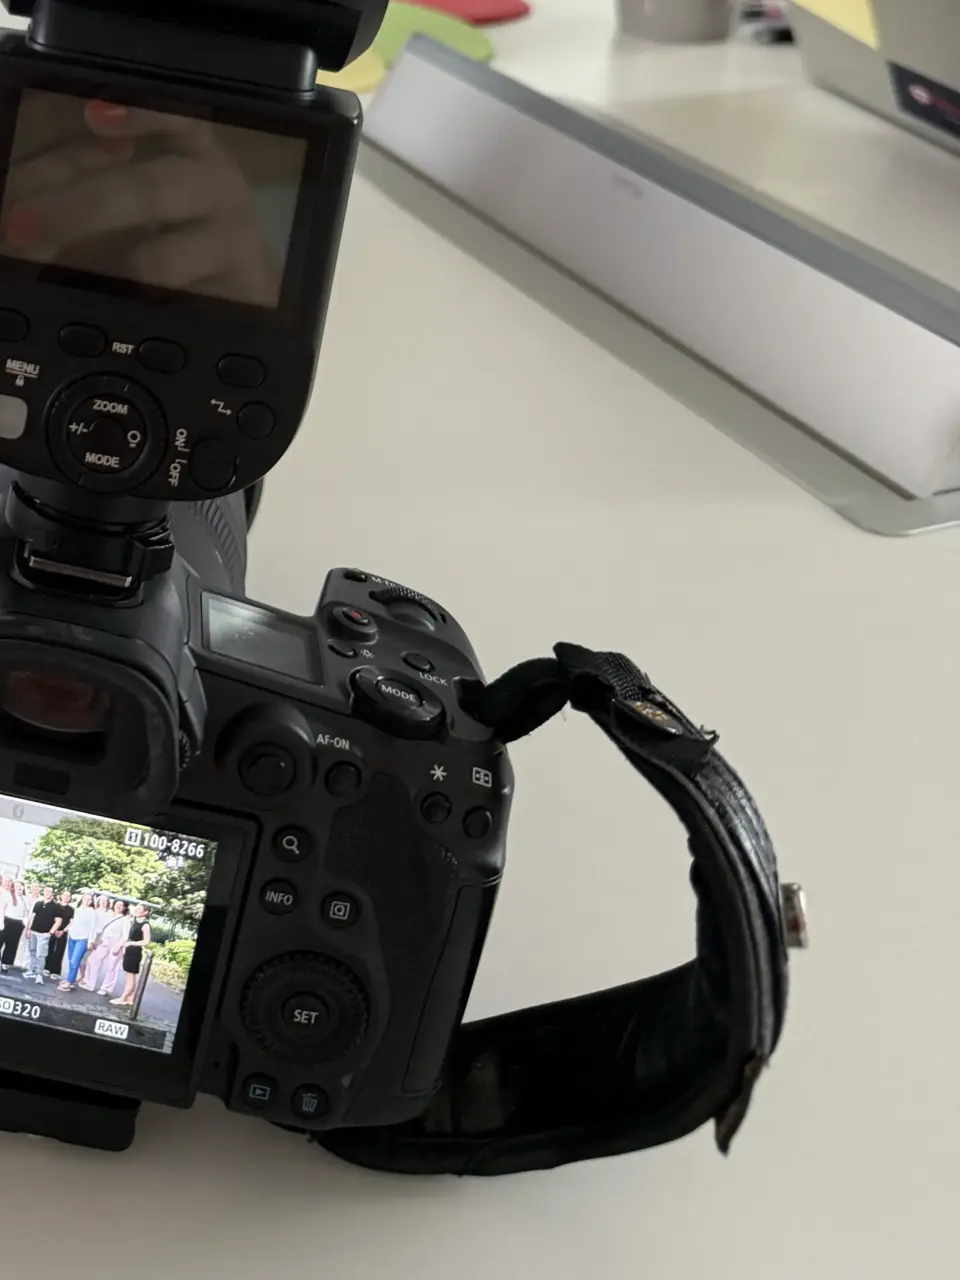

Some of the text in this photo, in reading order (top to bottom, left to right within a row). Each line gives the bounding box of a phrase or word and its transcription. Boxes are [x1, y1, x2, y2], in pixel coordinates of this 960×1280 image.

[112, 341, 135, 355] RST
[5, 358, 40, 375] MENU
[92, 399, 128, 415] ZOOM
[174, 428, 187, 446] ON
[84, 452, 121, 468] MODE
[168, 463, 181, 487] OFF
[419, 671, 448, 686] LOCK
[381, 683, 417, 703] MODE
[316, 734, 350, 750] AF-ON
[143, 832, 205, 858] 100-8266
[265, 890, 293, 906] INFO
[293, 1008, 320, 1026] SET
[97, 1020, 127, 1037] RAW
